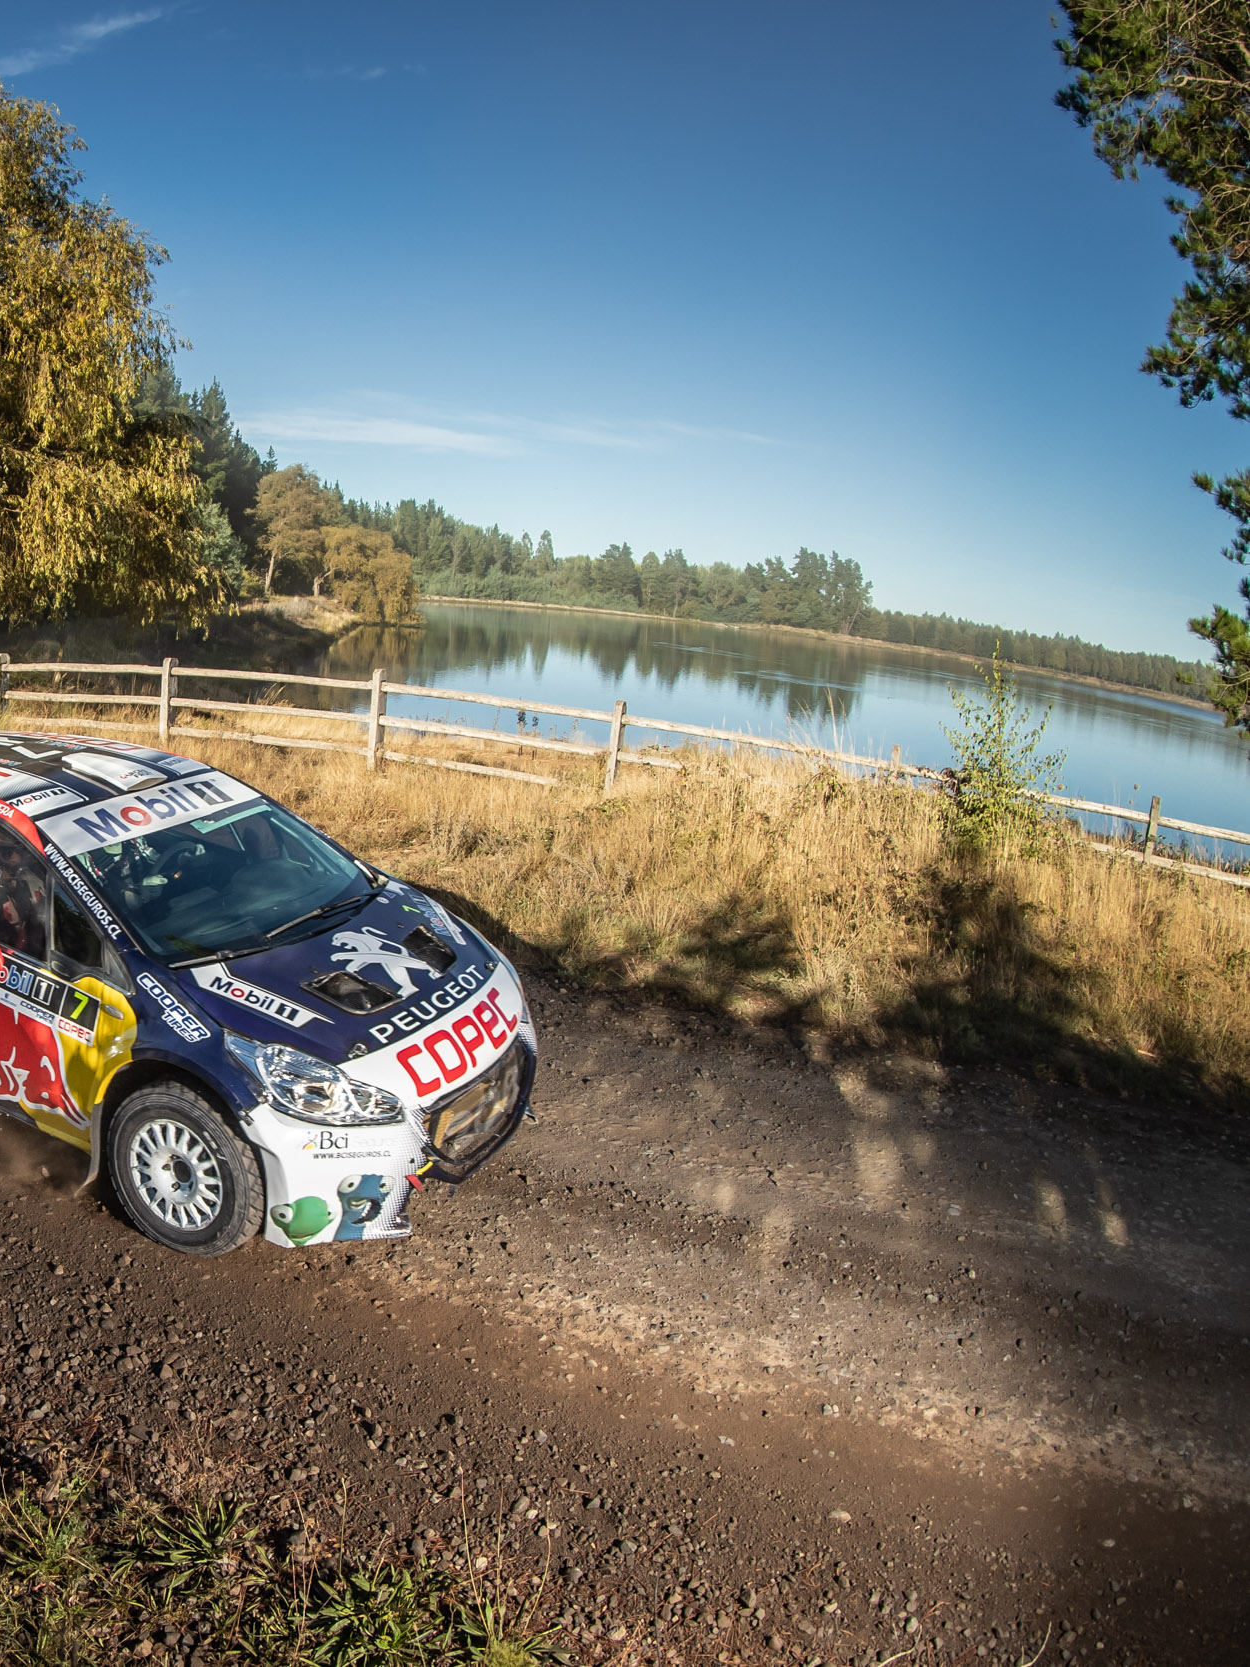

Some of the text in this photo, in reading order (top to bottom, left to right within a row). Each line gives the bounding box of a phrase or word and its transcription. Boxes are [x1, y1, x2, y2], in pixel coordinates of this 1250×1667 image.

[9, 788, 67, 807] Mobil 1
[73, 780, 232, 843] Mobil 1
[44, 843, 123, 940] WWW.BCISEGUROS.CL
[38, 981, 48, 1000] 1
[70, 991, 89, 1019] 7
[139, 973, 209, 1039] COOPER
[210, 976, 299, 1021] Mobil 1
[368, 965, 485, 1044] PEUGEOT
[20, 1000, 55, 1020] COOPER
[163, 1011, 199, 1042] TIRES
[320, 1131, 348, 1149] Bci
